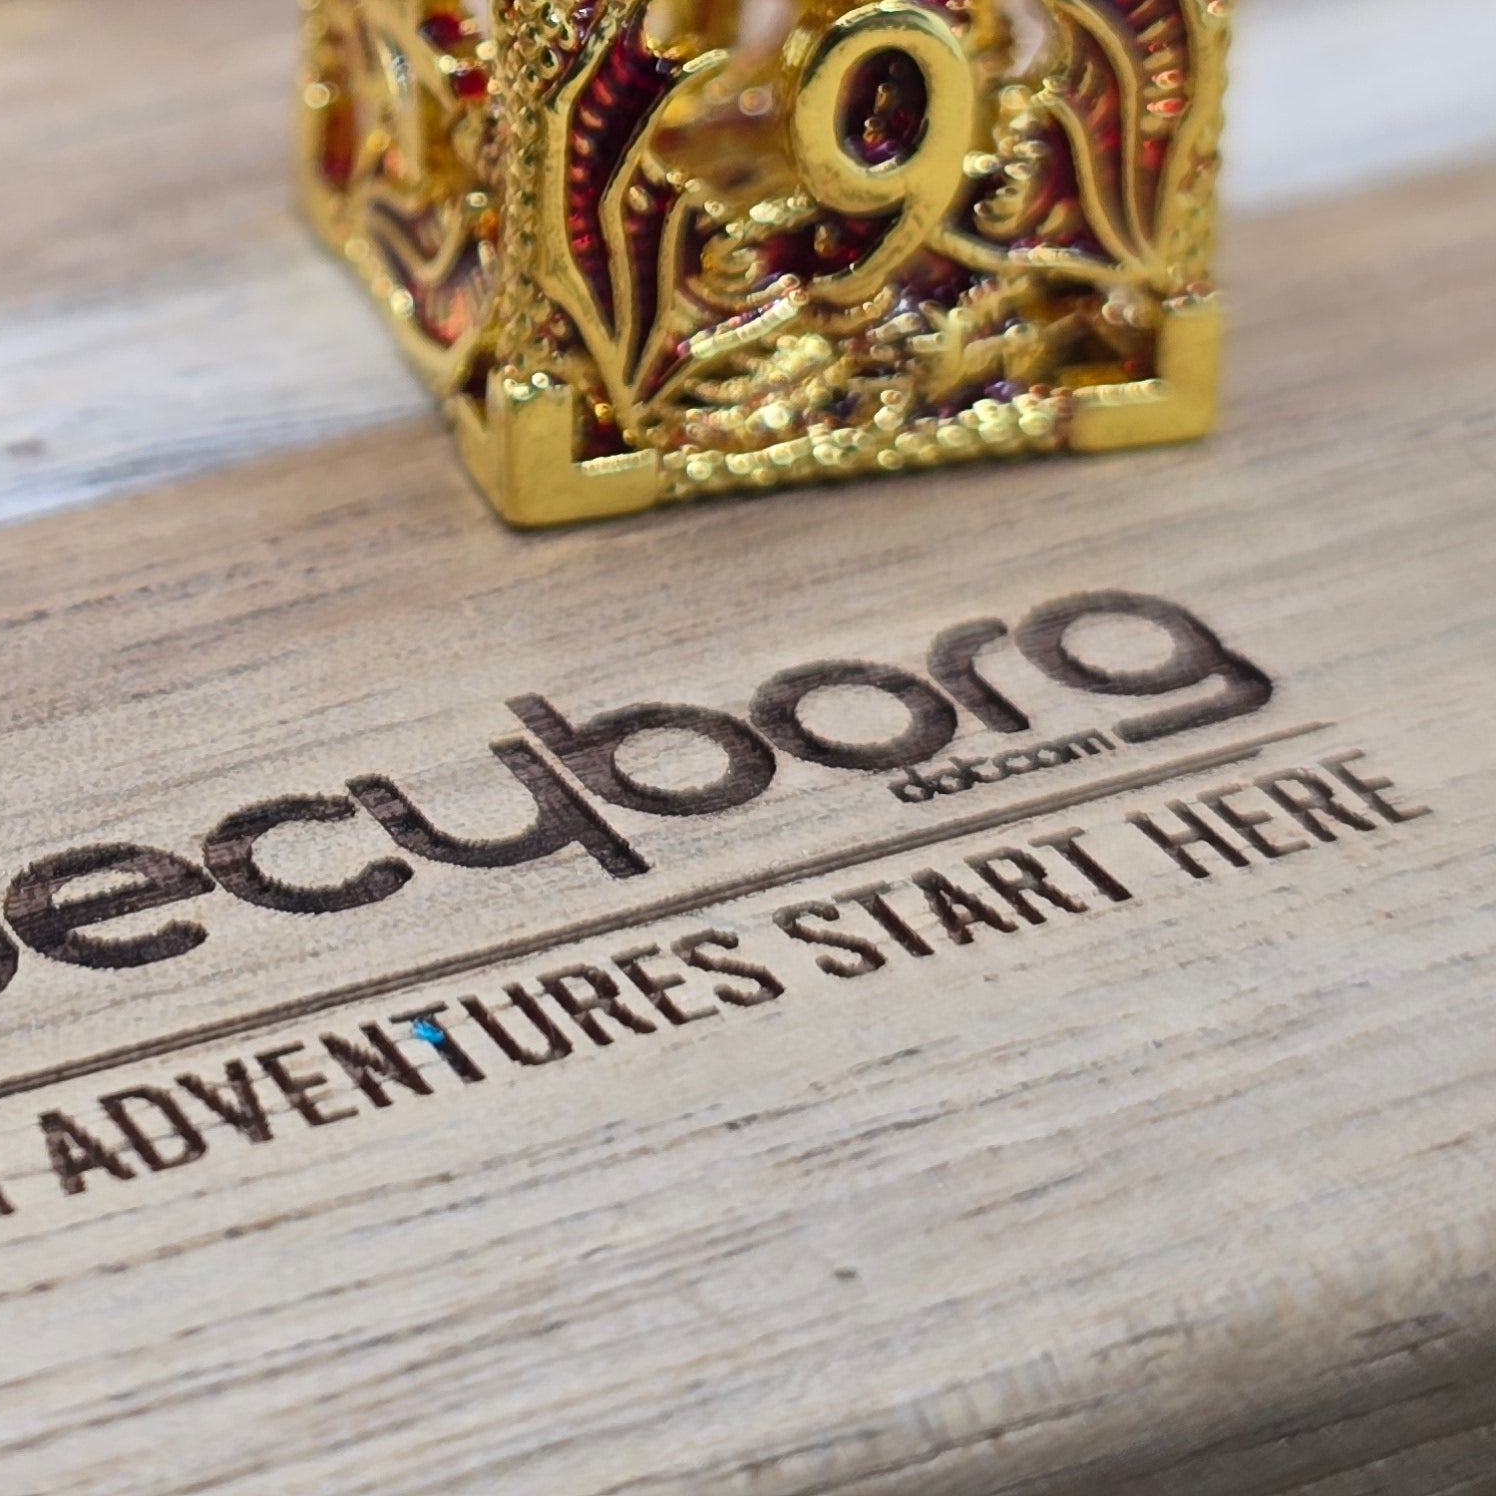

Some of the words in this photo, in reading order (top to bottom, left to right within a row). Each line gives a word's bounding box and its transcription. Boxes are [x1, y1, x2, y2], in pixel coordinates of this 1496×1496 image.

[38, 926, 787, 1196] ADVENTURES
[771, 826, 1134, 980] START
[1125, 747, 1434, 880] HERE
